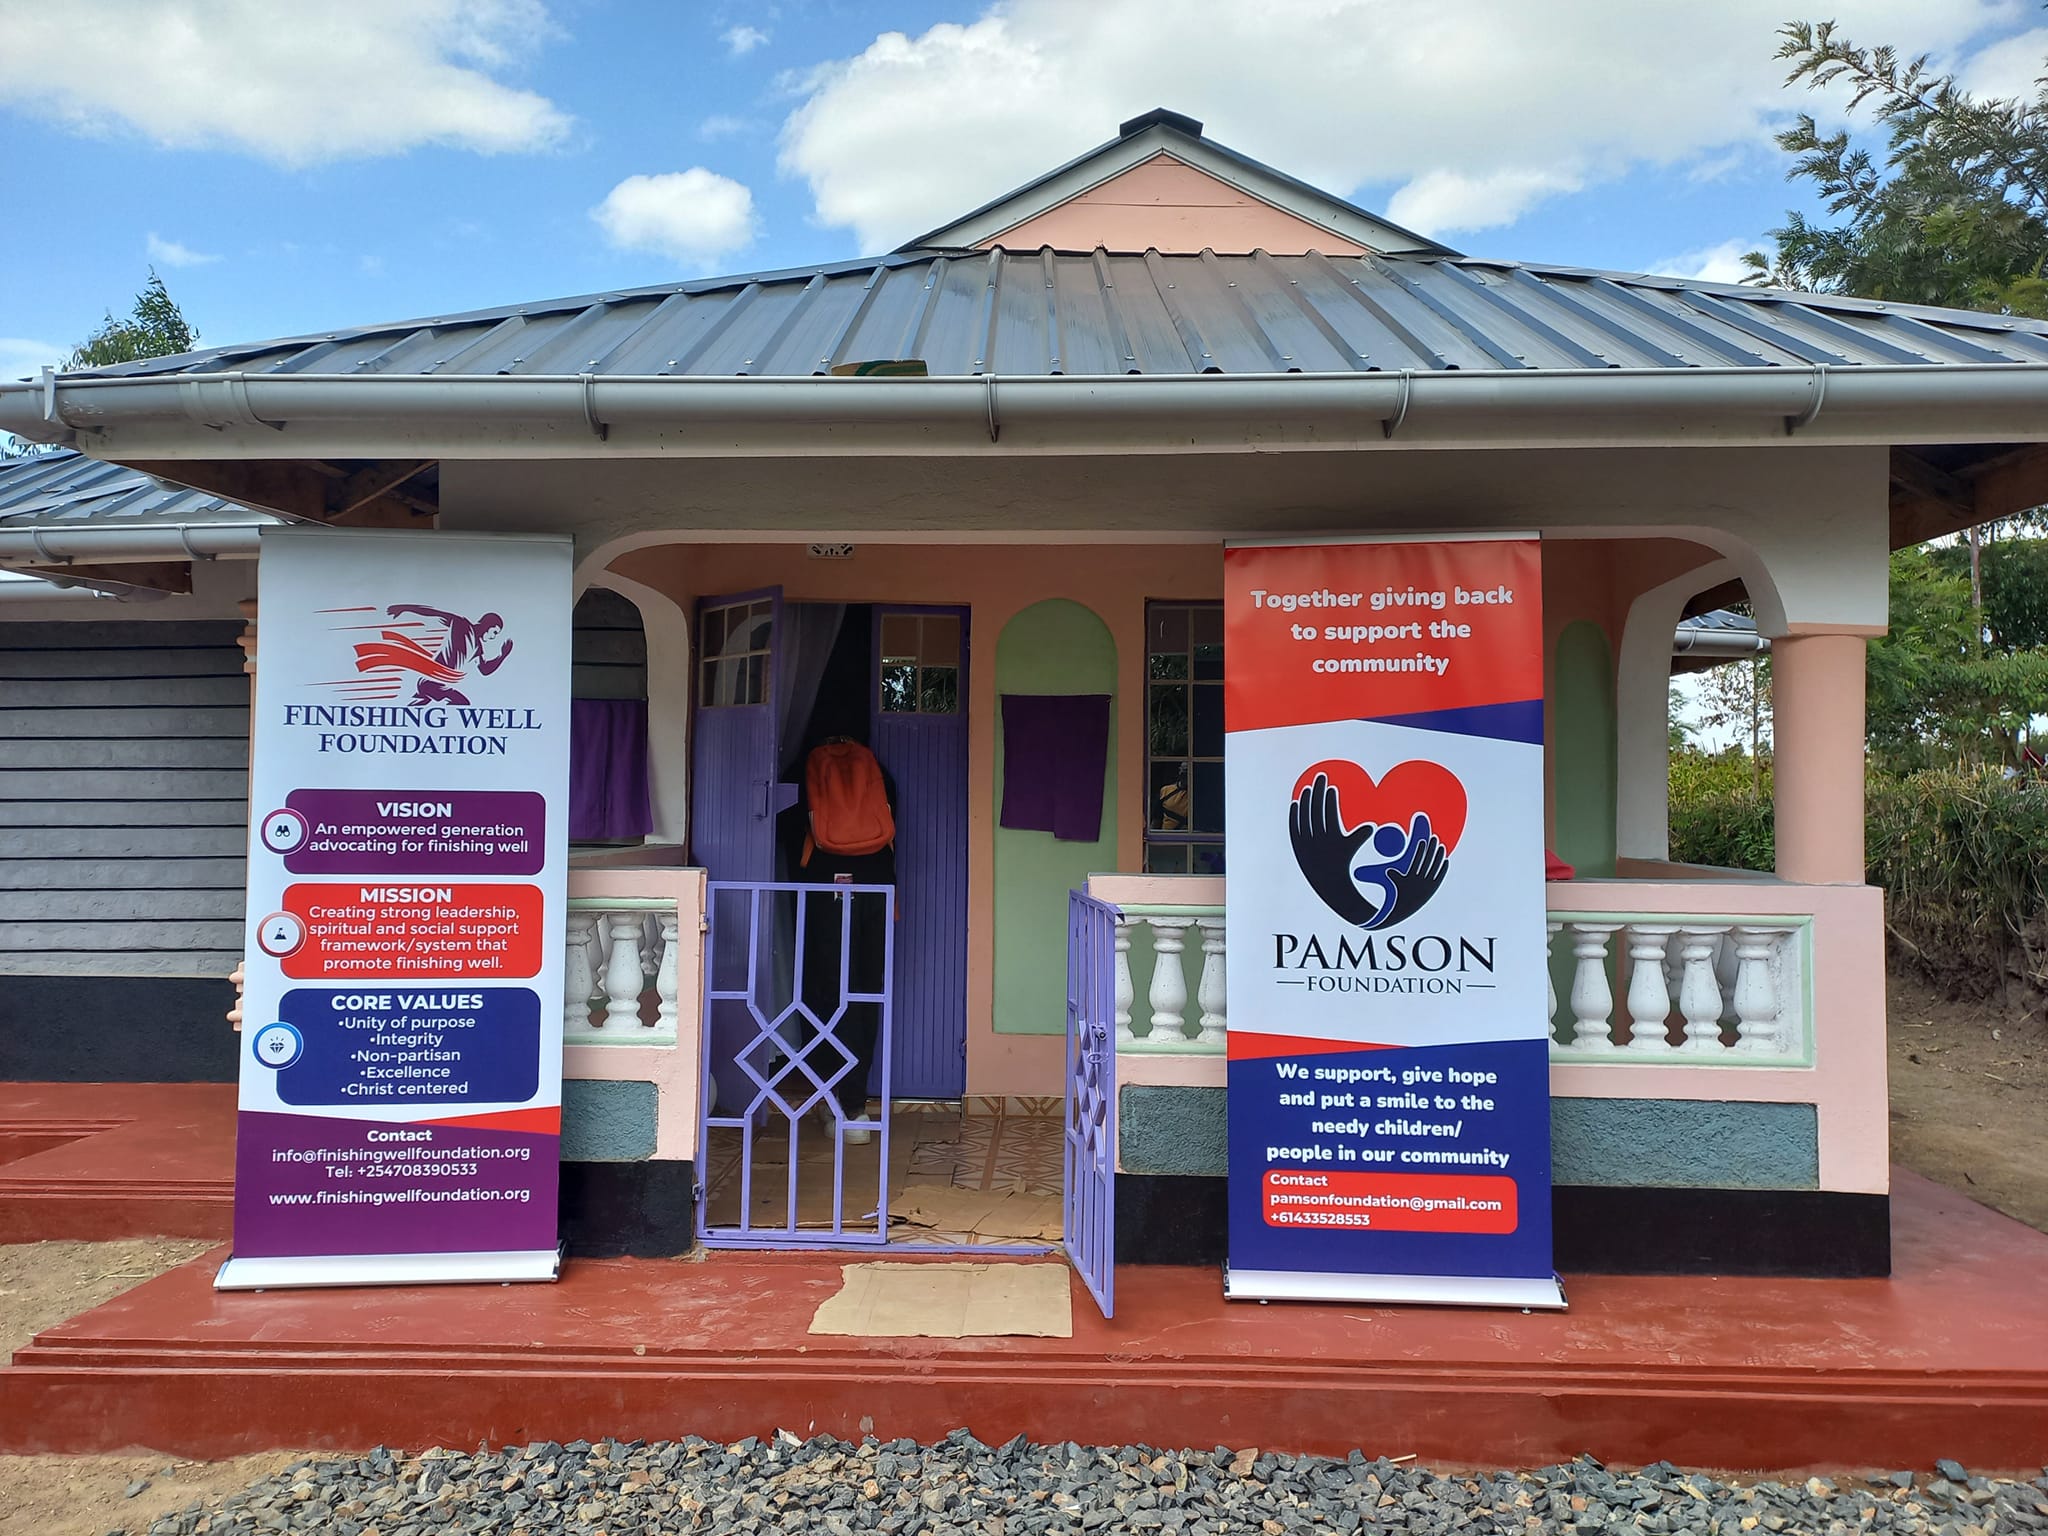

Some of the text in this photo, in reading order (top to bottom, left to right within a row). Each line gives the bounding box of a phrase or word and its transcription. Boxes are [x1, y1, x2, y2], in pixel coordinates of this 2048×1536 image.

[1250, 586, 1513, 612] Together giving back
[1291, 620, 1471, 643] to support the
[1312, 653, 1449, 675] community
[283, 705, 542, 729] FINISHING WELL
[318, 733, 508, 755] FOUNDATION
[377, 803, 452, 817] VISION
[315, 824, 523, 837] An empowered generation
[310, 840, 528, 855] advocating for finishing well
[360, 889, 451, 902] MISSION
[309, 906, 520, 921] Creating strong leadership,
[310, 923, 519, 937] spiritual and social support
[321, 939, 508, 953] framework/system that
[1272, 934, 1497, 973] PAMSON
[324, 957, 503, 972] promote finishing well.
[1307, 976, 1462, 994] FOUNDATION
[332, 995, 483, 1010] CORE VALUES
[391, 1017, 407, 1028] of
[411, 1018, 475, 1031] purpose
[1276, 1063, 1497, 1087] We support, give hope
[398, 1082, 468, 1094] centered
[1280, 1092, 1494, 1110] and put a smile to the
[367, 1130, 432, 1142] Contact
[1312, 1119, 1462, 1138] needy children/
[272, 1147, 530, 1164] info@finishingwellfoundation.org
[1267, 1144, 1509, 1168] people in our community
[326, 1163, 477, 1178] Tel: +254708390533
[1270, 1174, 1328, 1186] Contact
[269, 1188, 530, 1205] www.finishingwellfoundation.org
[1270, 1192, 1501, 1211] pamsonfoundation@gmail.com
[1271, 1212, 1370, 1226] +61433528553
